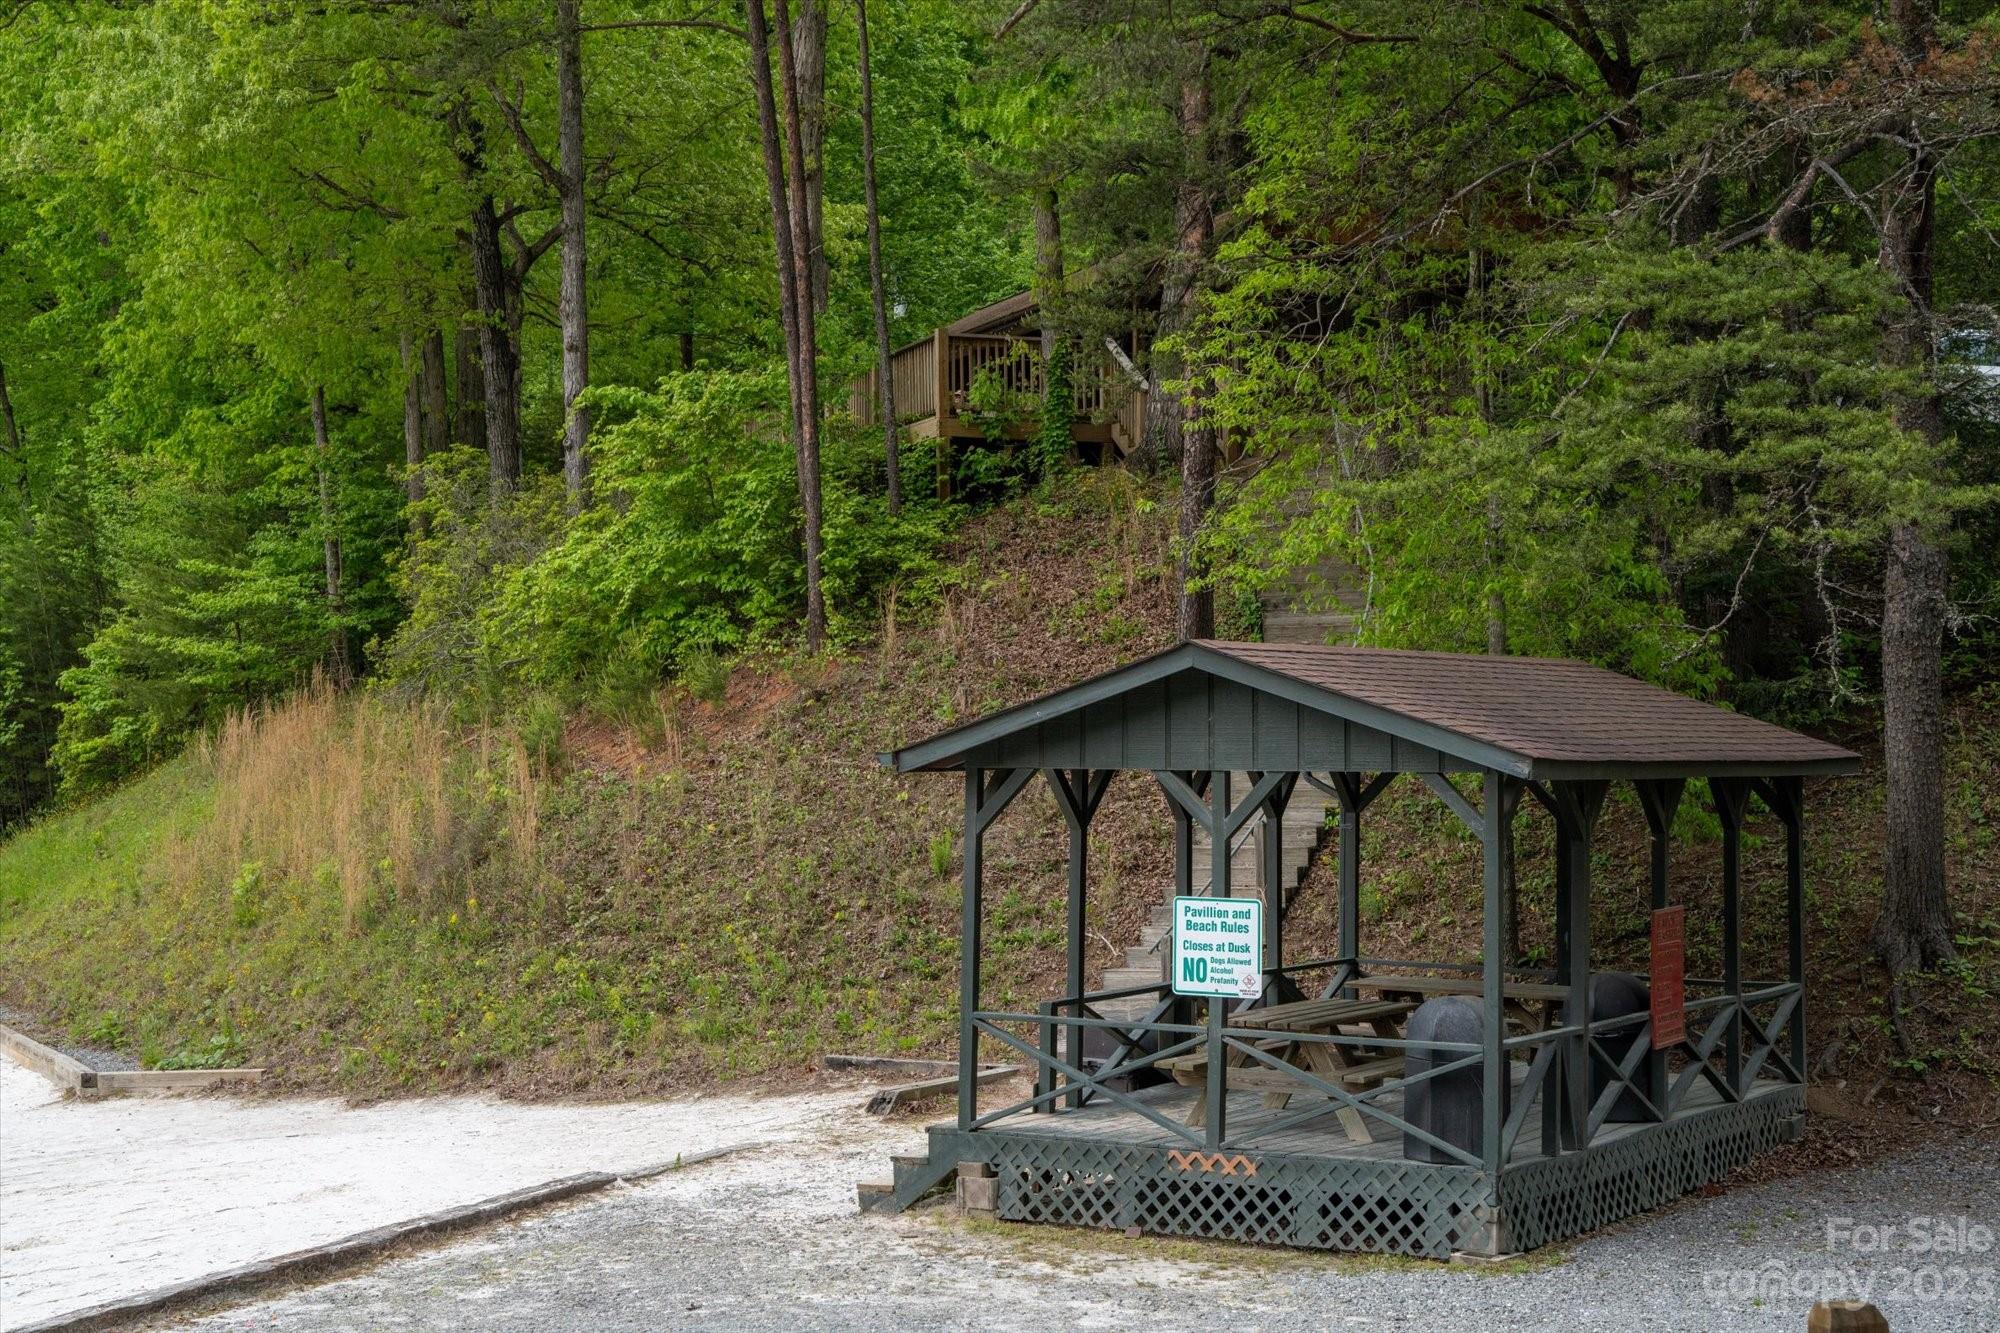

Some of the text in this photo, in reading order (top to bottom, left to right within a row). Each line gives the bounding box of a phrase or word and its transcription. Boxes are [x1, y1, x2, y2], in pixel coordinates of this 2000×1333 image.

[1184, 905, 1251, 919] Pavillion and
[1186, 919, 1249, 933] Beach Rules
[1183, 939, 1251, 953] Closes at Dusk
[1210, 956, 1251, 966] Dogs Allowed
[1183, 957, 1207, 983] NO
[1210, 967, 1233, 975] Alcohol
[1210, 976, 1238, 986] Profanity
